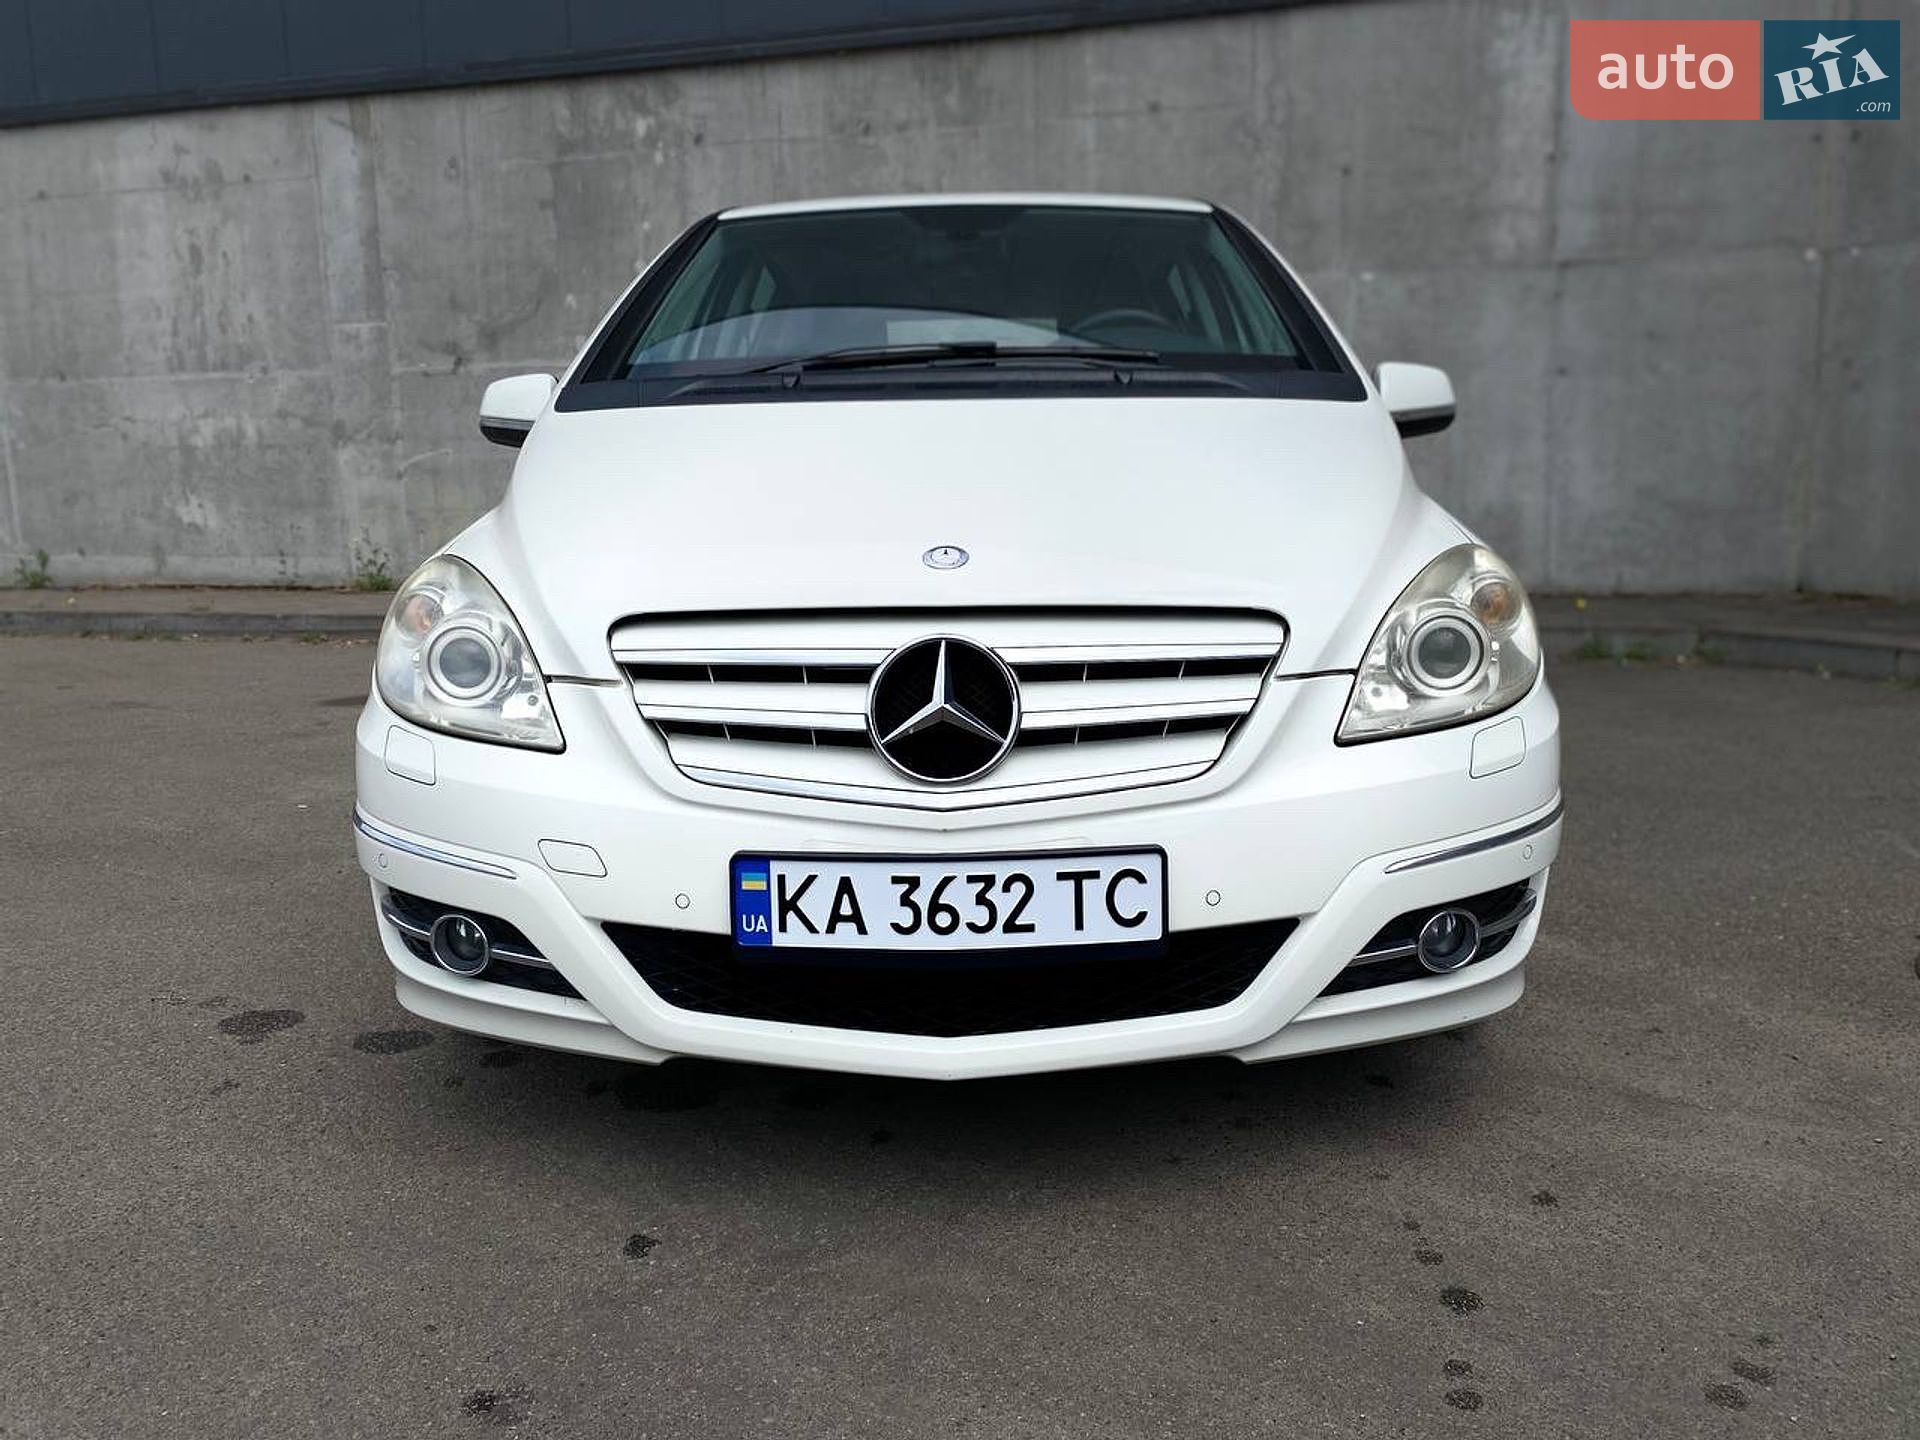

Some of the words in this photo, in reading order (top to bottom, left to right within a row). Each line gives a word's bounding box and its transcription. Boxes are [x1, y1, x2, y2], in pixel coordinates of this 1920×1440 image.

[776, 873, 869, 936] KA
[889, 872, 1036, 936] 3632
[1055, 867, 1149, 932] TC
[742, 914, 769, 934] UA
